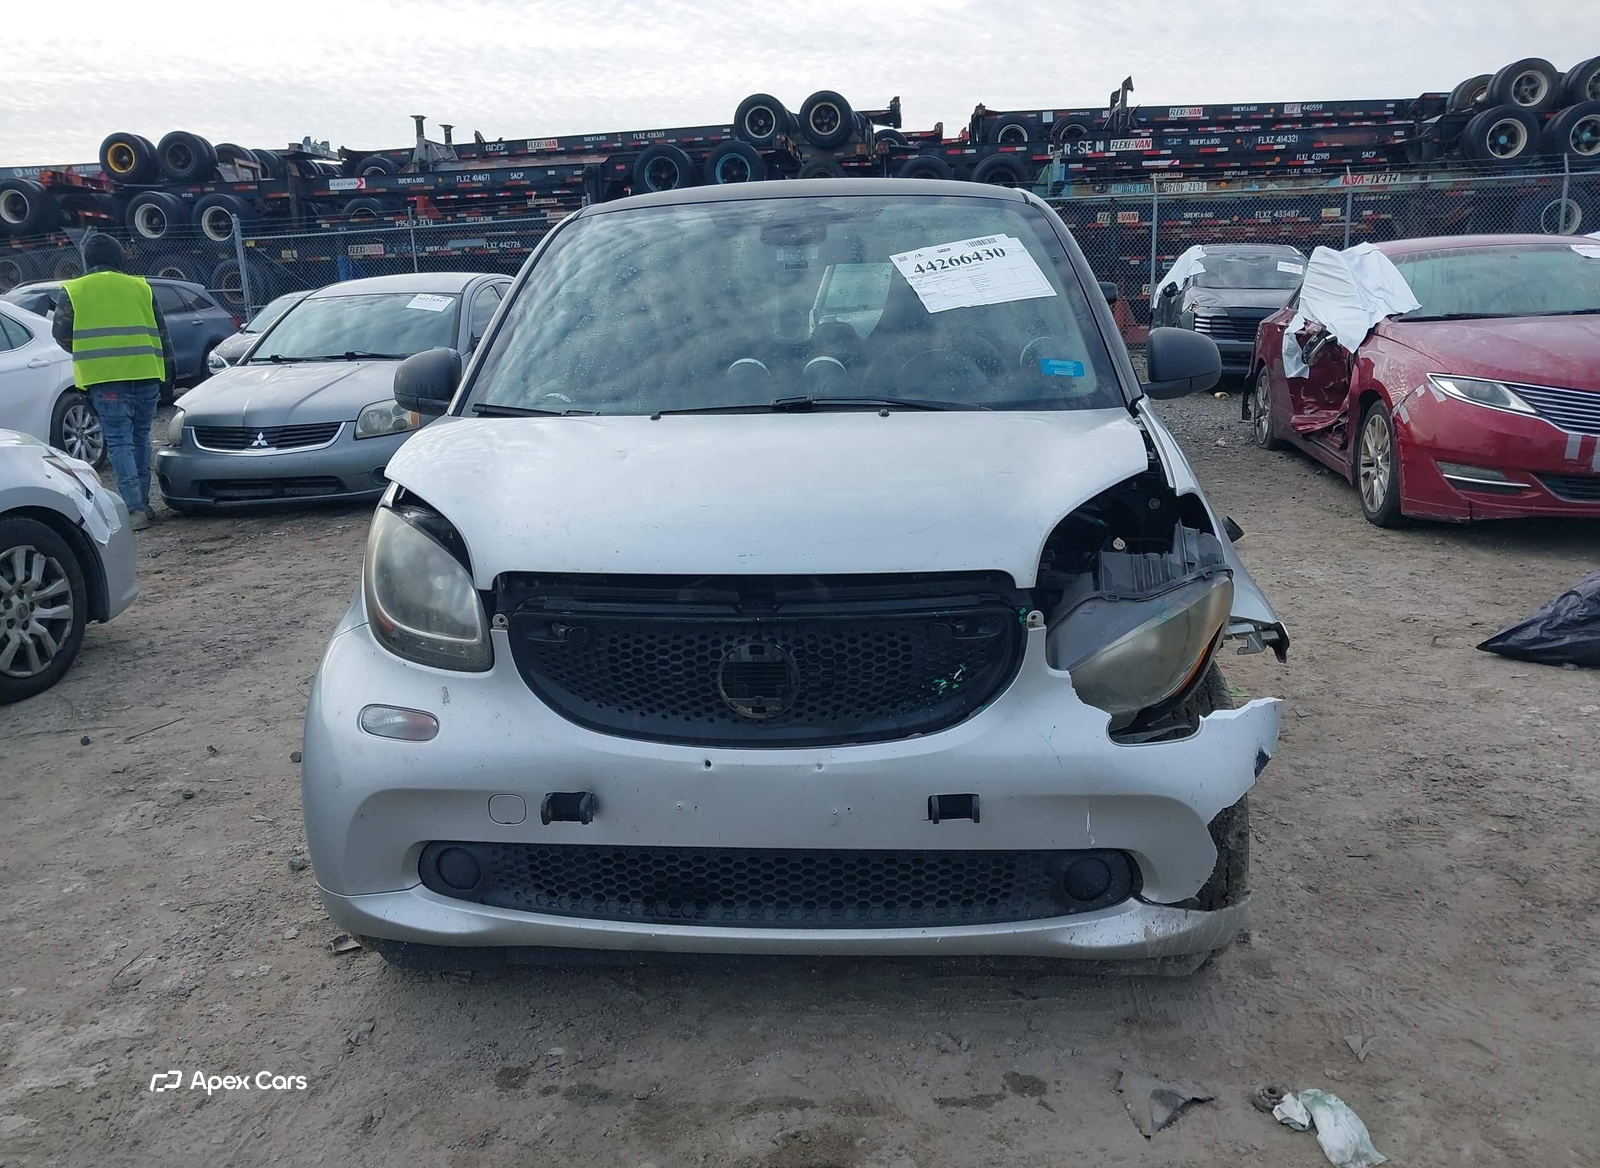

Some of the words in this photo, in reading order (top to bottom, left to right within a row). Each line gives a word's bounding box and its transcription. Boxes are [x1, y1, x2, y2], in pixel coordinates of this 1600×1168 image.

[1170, 108, 1202, 116] FLEXI-VAN
[1258, 136, 1274, 144] FLXZ
[528, 141, 557, 149] FLEXI-VAN
[1111, 140, 1151, 149] FLEXI-VAN
[456, 175, 471, 183] FLXZ
[510, 172, 524, 180] SACP
[1274, 210, 1299, 218] 433487
[914, 247, 1006, 273] 44266430
